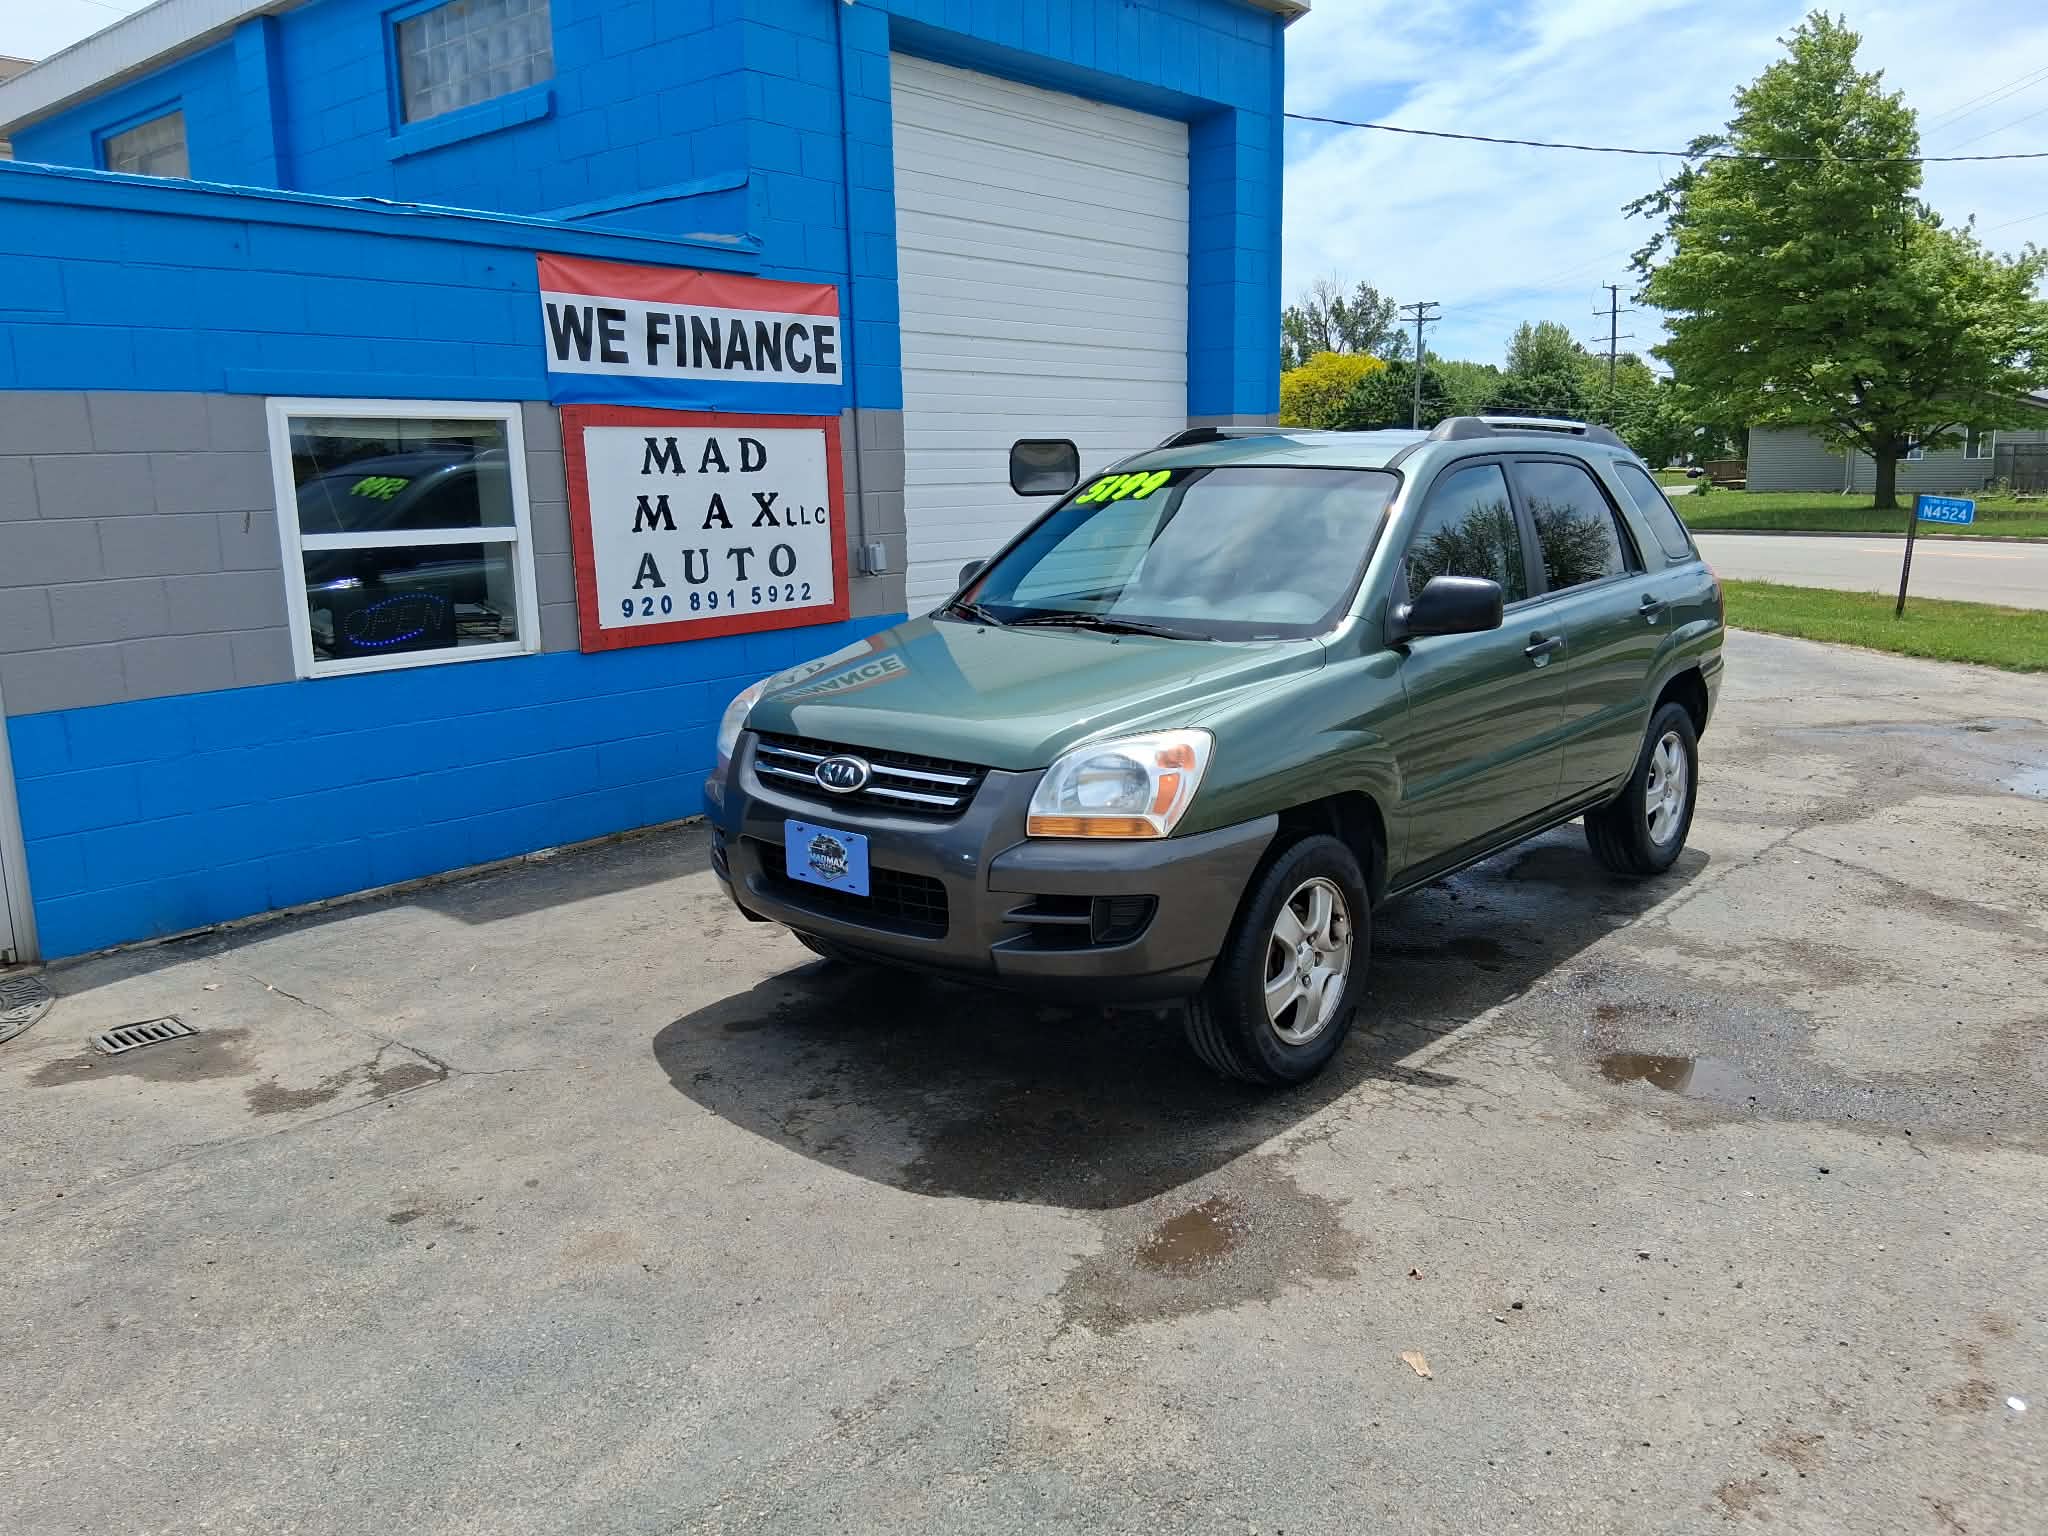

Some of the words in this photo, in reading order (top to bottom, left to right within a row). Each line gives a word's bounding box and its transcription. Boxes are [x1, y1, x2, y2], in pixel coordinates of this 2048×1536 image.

[546, 303, 630, 364] WE
[646, 312, 837, 374] FINANCE
[641, 437, 767, 475] MAD
[632, 492, 780, 533] MAX
[786, 506, 826, 528] LLC
[1923, 504, 1967, 520] N4524
[632, 544, 797, 590] AUTO
[622, 595, 673, 618] 920
[690, 589, 735, 612] 891
[752, 583, 812, 605] 5922
[344, 602, 445, 637] OPEN
[823, 763, 855, 784] KIA
